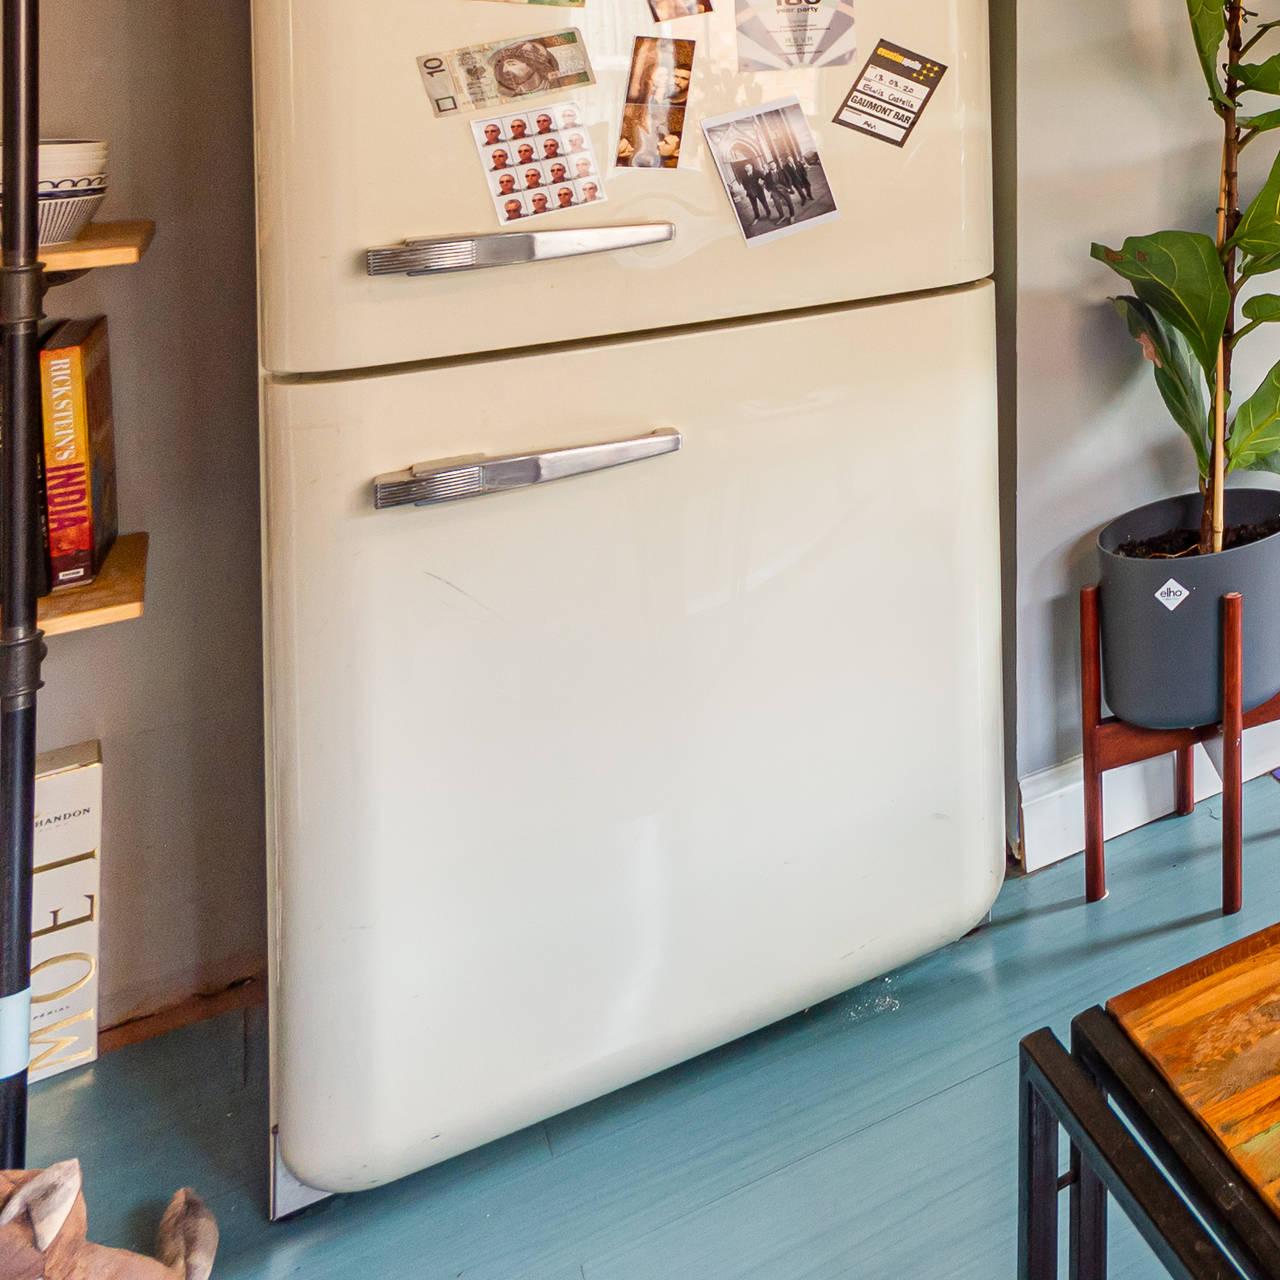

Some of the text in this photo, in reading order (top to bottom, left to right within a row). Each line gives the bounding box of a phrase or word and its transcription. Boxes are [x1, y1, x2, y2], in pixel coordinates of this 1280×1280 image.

[796, 6, 819, 14] party
[422, 56, 447, 79] 10
[850, 95, 893, 118] GAUMONT
[892, 109, 913, 126] BAR
[46, 358, 88, 533] RICK STEIN'S INDIA
[1160, 586, 1183, 598] elho
